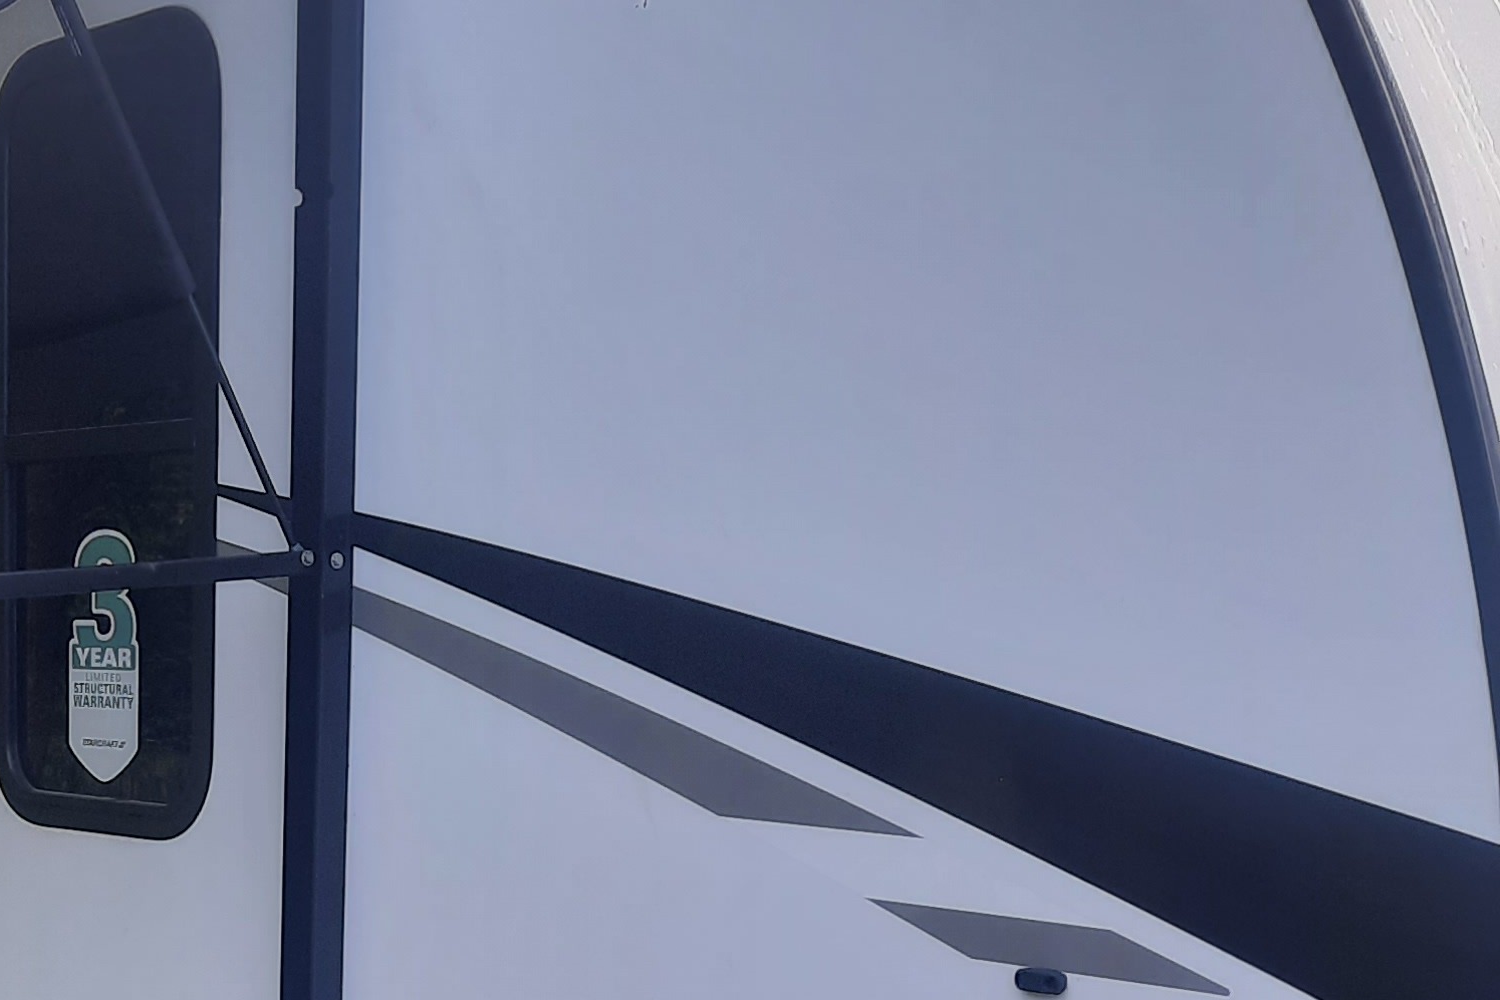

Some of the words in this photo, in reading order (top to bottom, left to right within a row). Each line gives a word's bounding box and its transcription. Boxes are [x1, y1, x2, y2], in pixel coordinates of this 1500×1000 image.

[73, 528, 137, 645] 3
[75, 647, 132, 668] YEAR
[86, 672, 122, 682] LIMITED
[74, 682, 134, 695] STRUCTURAL
[73, 695, 134, 709] WARRANTY
